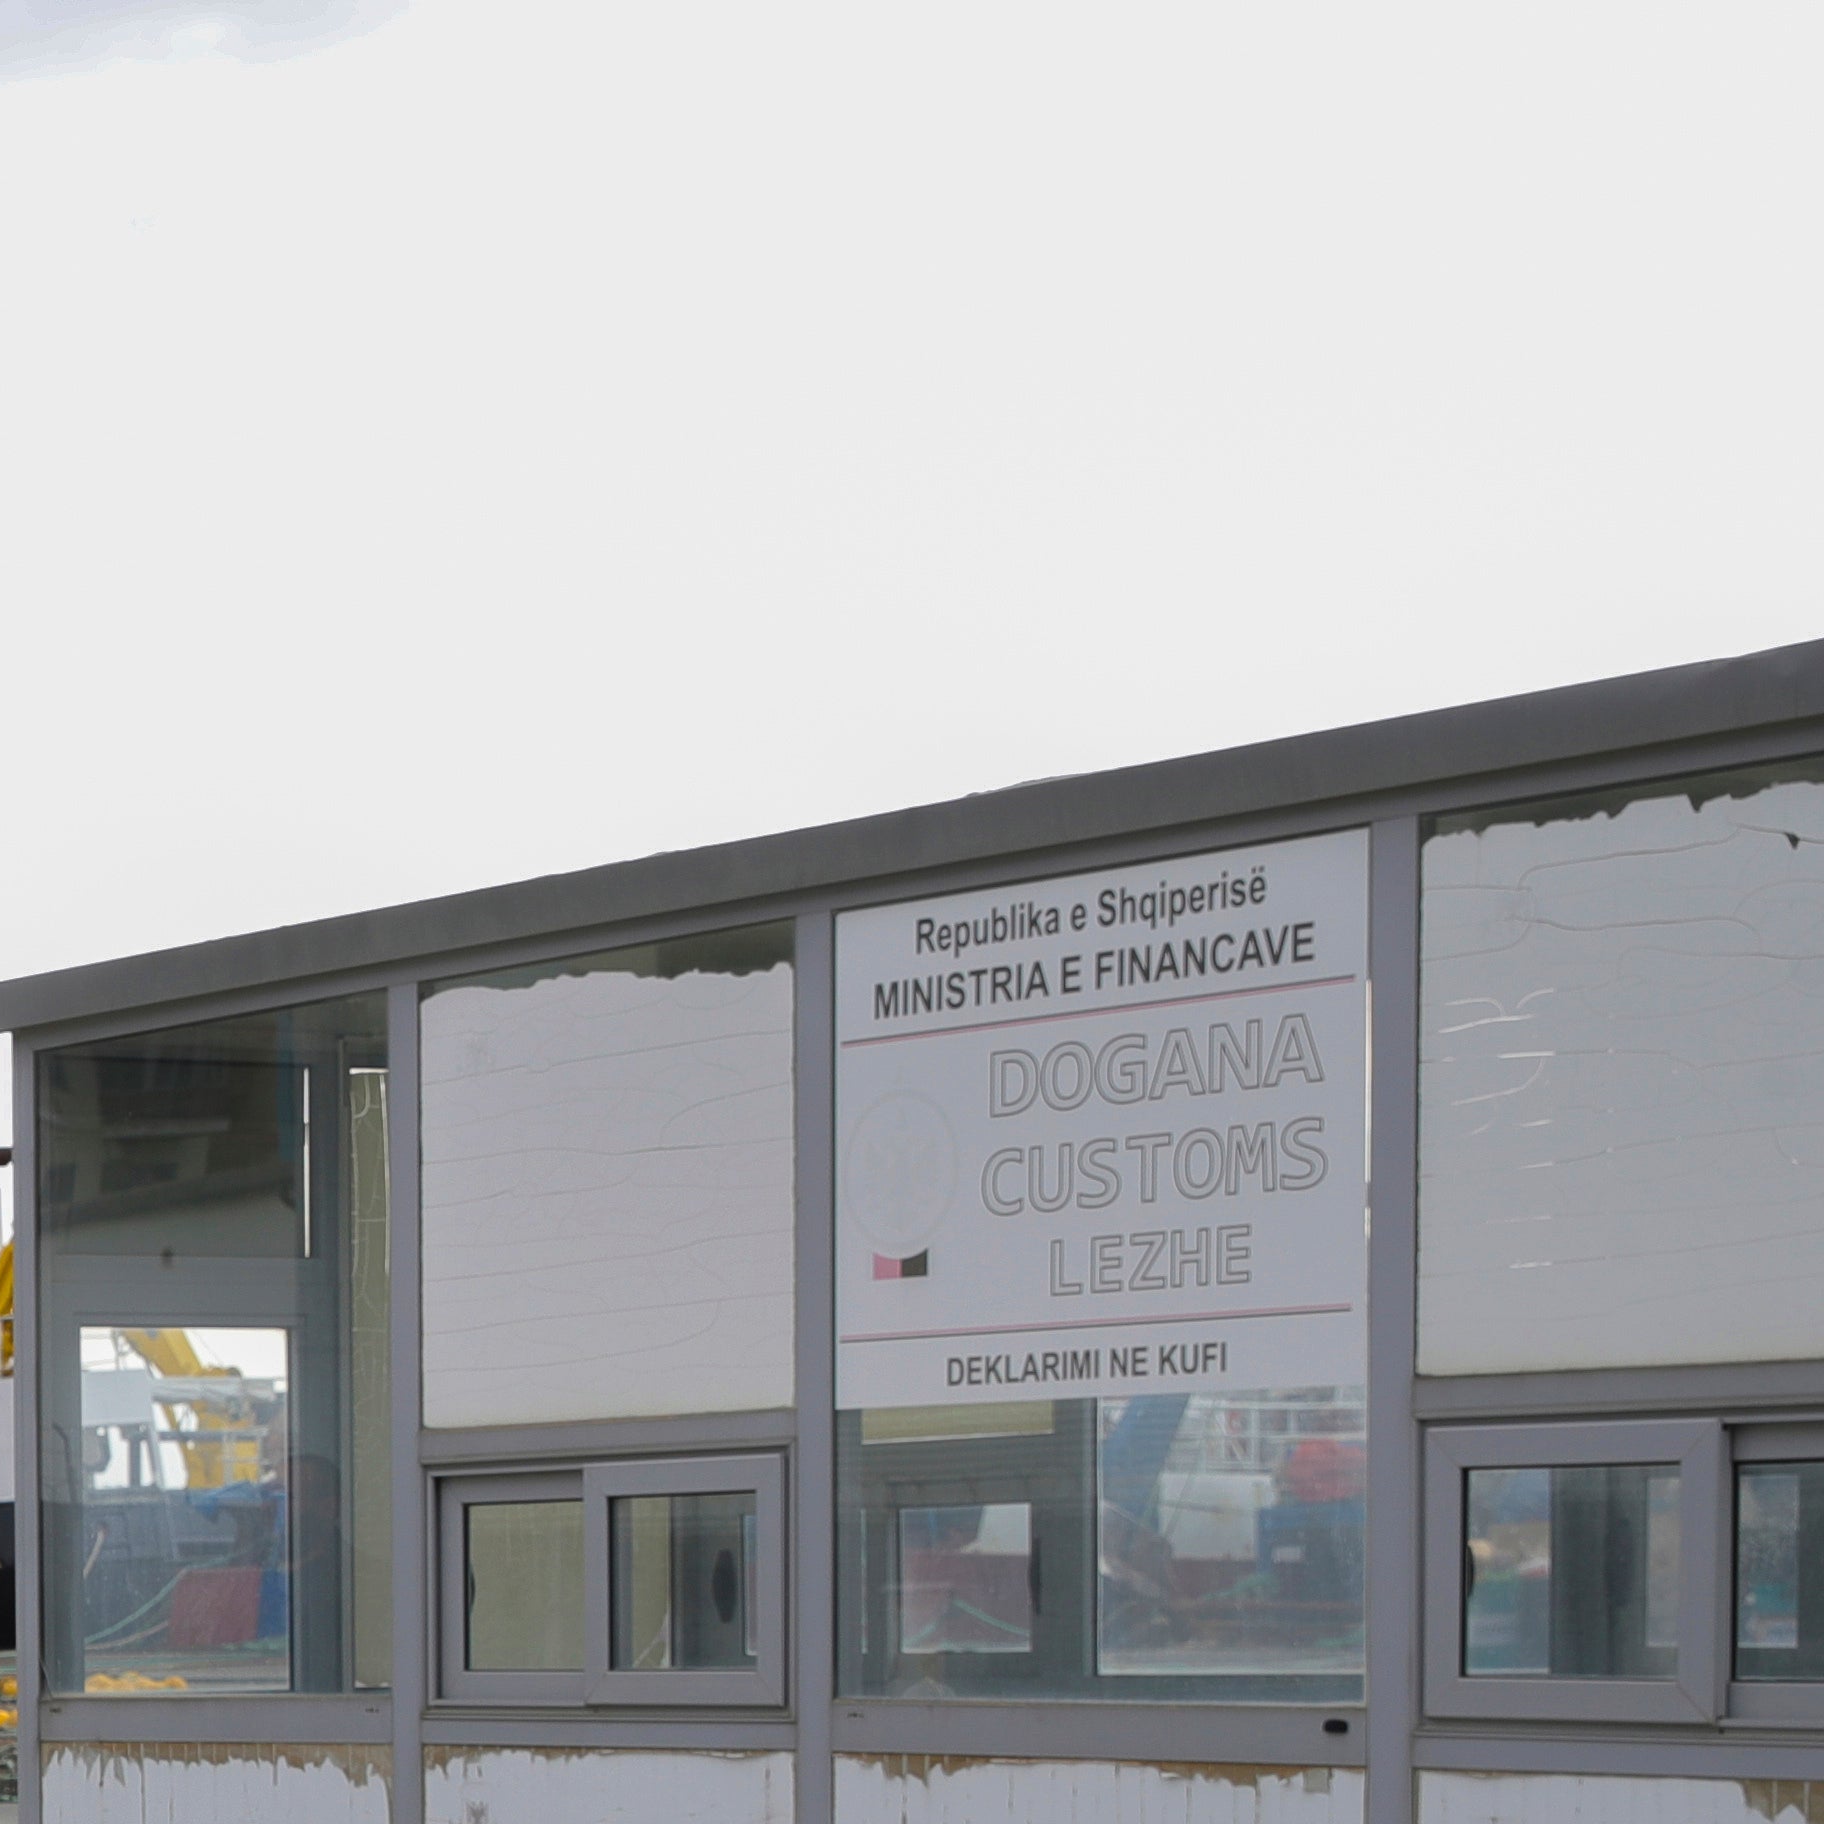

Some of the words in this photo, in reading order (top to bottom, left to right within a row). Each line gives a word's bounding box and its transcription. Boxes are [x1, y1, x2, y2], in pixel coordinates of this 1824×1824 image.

[916, 903, 1061, 958] Republika
[1071, 901, 1087, 932] e
[1098, 866, 1267, 927] Shqiperisë
[873, 961, 1049, 1020] MINISTRIA
[1061, 957, 1081, 995] E
[1096, 922, 1315, 991] FINANCAVE
[989, 1013, 1325, 1118] DOGANA
[980, 1117, 1329, 1217] CUSTOMS
[1050, 1223, 1253, 1297] LEZHE
[947, 1348, 1101, 1386] DEKLARIMI
[1110, 1346, 1148, 1378] NE
[1159, 1342, 1227, 1377] KUFI
